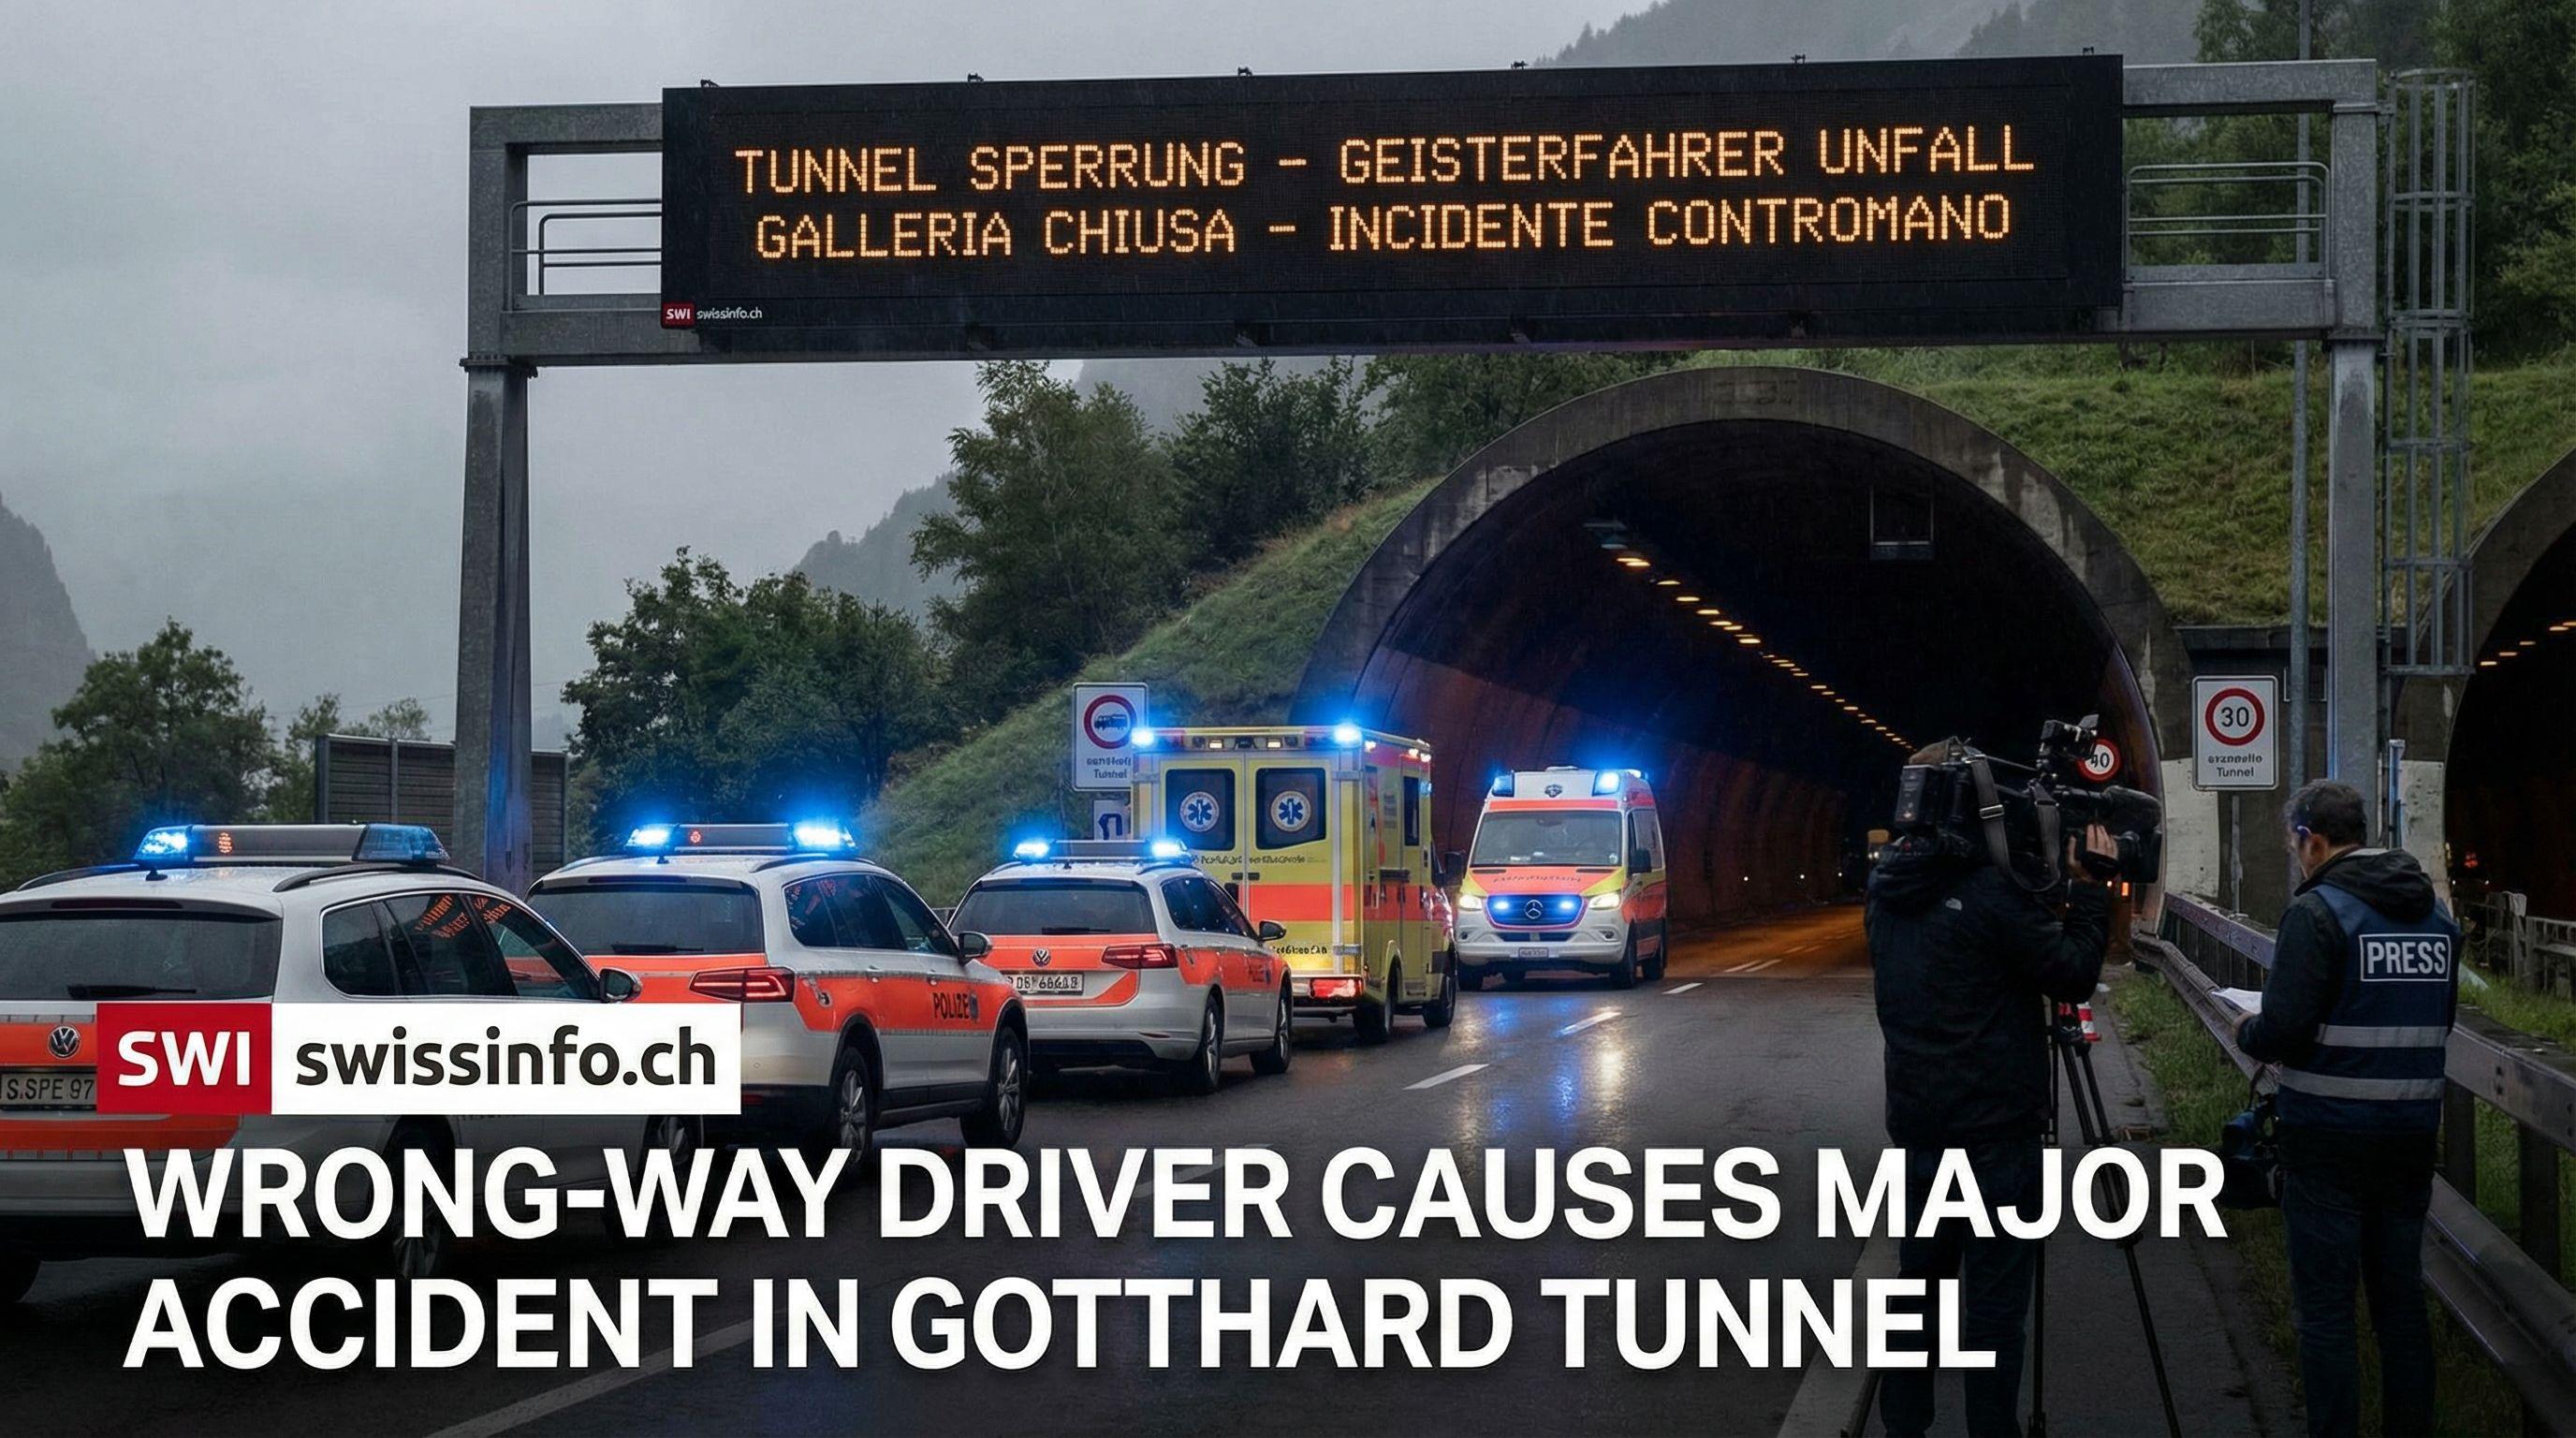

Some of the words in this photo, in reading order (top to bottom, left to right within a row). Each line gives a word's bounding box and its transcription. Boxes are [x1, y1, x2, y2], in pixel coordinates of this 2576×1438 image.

[735, 147, 937, 194] TUNNEL
[970, 141, 1245, 191] SPERRUNG
[1340, 130, 1785, 183] GEISTERFAHRER
[1820, 125, 2035, 175] UNFALL
[757, 212, 1012, 258] GALLERIA
[1045, 209, 1236, 255] CHIUSA
[1329, 201, 1615, 251] INCIDENTE
[1647, 194, 2011, 245] CONTROMANO
[666, 308, 691, 319] SWI
[696, 306, 763, 319] swissinfo.ch
[2221, 707, 2249, 727] 30
[2217, 767, 2254, 777] Tunnel
[2367, 941, 2446, 974] PRESS
